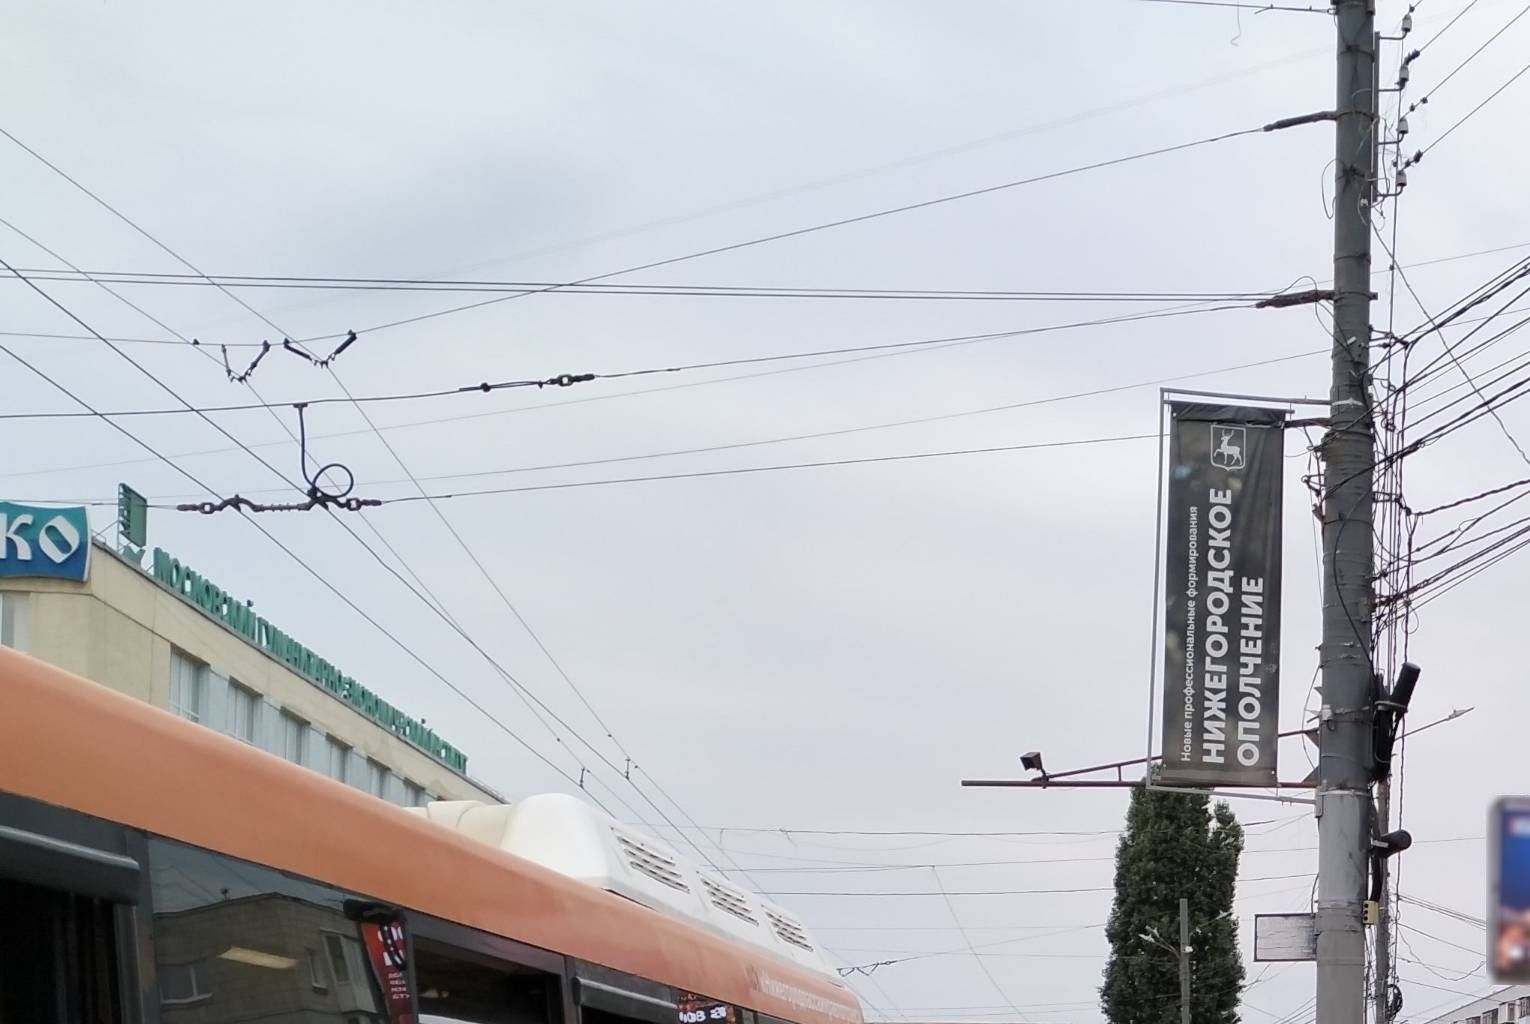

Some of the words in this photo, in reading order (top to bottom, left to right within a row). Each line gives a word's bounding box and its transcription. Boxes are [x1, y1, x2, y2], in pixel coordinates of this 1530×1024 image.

[1184, 505, 1199, 598] формирования
[1182, 599, 1197, 718] профессиональные
[1201, 487, 1234, 764] НИЖЕГОРОДСКОЕ
[1236, 576, 1265, 767] ОПОЛЧЕНИЕ
[1180, 715, 1193, 762] Новые
